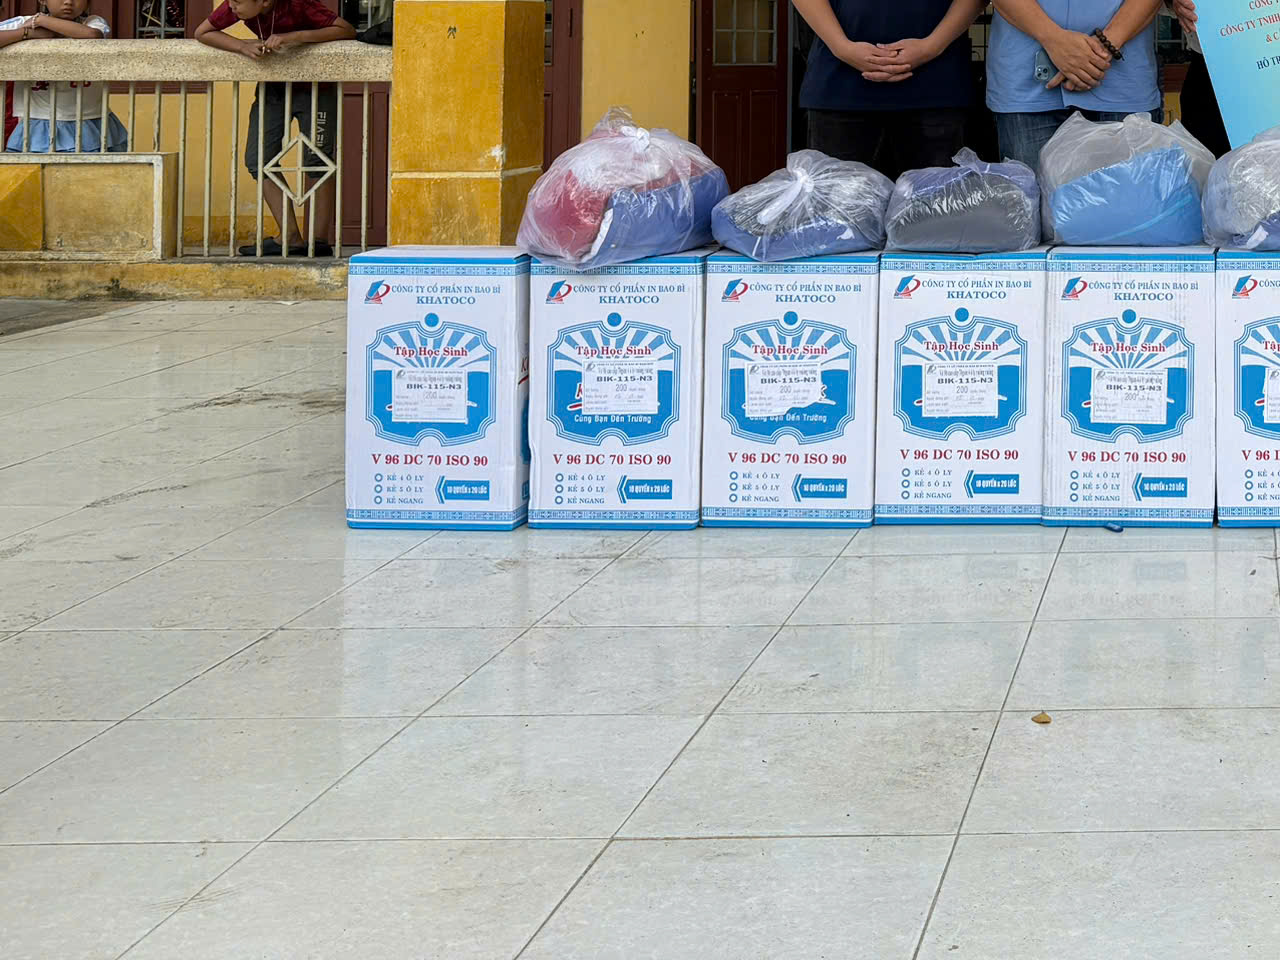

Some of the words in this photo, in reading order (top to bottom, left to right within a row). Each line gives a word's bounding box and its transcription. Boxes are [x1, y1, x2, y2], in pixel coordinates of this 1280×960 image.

[1220, 22, 1244, 36] CÔNG
[1244, 19, 1255, 29] TY
[1256, 12, 1280, 26] TNHH
[1265, 34, 1272, 42] &
[417, 296, 476, 305] KHATOCO
[599, 295, 659, 304] KHATOCO
[775, 294, 836, 303] KHATOCO
[947, 291, 1007, 299] KHATOCO
[1114, 291, 1174, 301] KHATOCO
[394, 346, 415, 358] Tập
[418, 346, 440, 358] Học
[443, 346, 468, 356] Sinh
[576, 346, 598, 357] Tập
[601, 346, 622, 357] Học
[625, 346, 651, 355] Sinh
[753, 345, 774, 356] Tập
[777, 345, 799, 356] Học
[802, 345, 828, 354] Sinh
[924, 341, 946, 353] Tập
[949, 341, 970, 353] Học
[973, 341, 999, 351] Sinh
[1091, 343, 1112, 354] Tập
[1116, 343, 1137, 354] Học
[1140, 343, 1166, 352] Sinh
[371, 454, 381, 466] V
[384, 454, 400, 466] 96
[403, 454, 424, 466] DC
[428, 454, 442, 466] 70
[446, 454, 470, 466] ISO
[474, 454, 488, 466] 90
[1068, 451, 1078, 463] V
[1081, 451, 1096, 463] 96
[1100, 451, 1120, 463] DC
[1124, 451, 1139, 463] 70
[1143, 451, 1167, 463] ISO
[1172, 451, 1186, 463] 90
